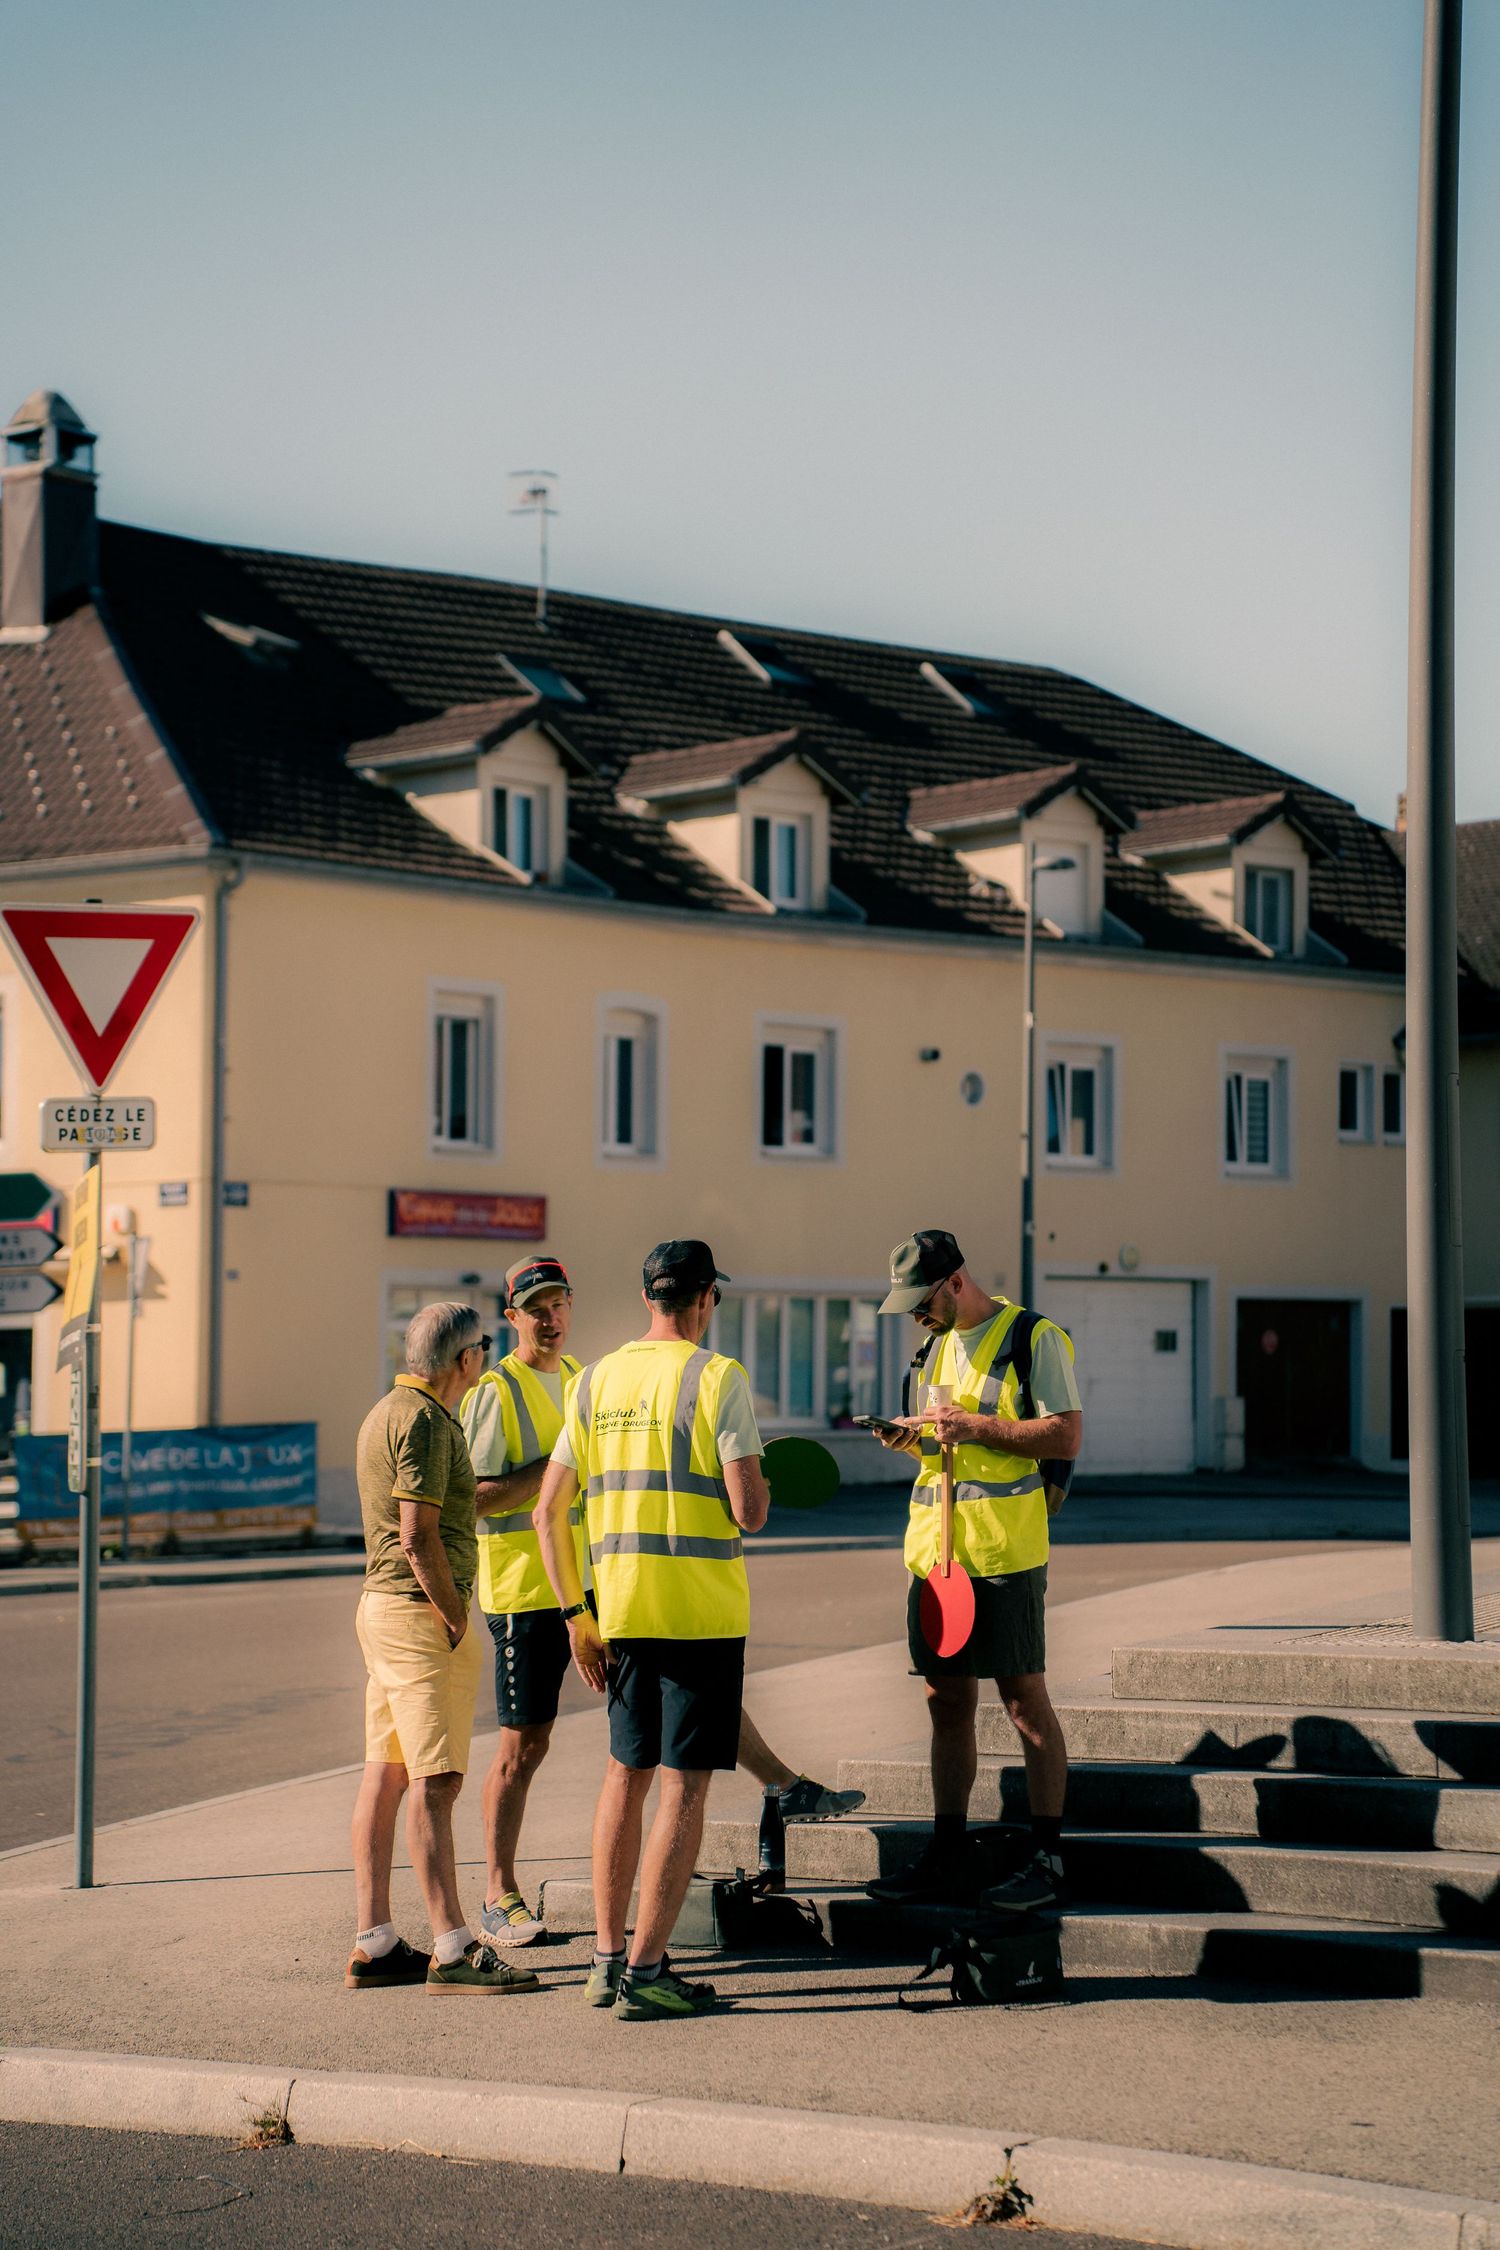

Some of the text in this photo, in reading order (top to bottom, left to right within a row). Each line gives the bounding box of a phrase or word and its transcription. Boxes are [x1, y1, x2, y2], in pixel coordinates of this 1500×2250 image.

[55, 1105, 145, 1122] CÉDEZ LE
[58, 1127, 142, 1141] PAGE
[594, 1408, 637, 1422] Skiclub
[168, 1447, 200, 1471] DE
[204, 1446, 236, 1469] LA
